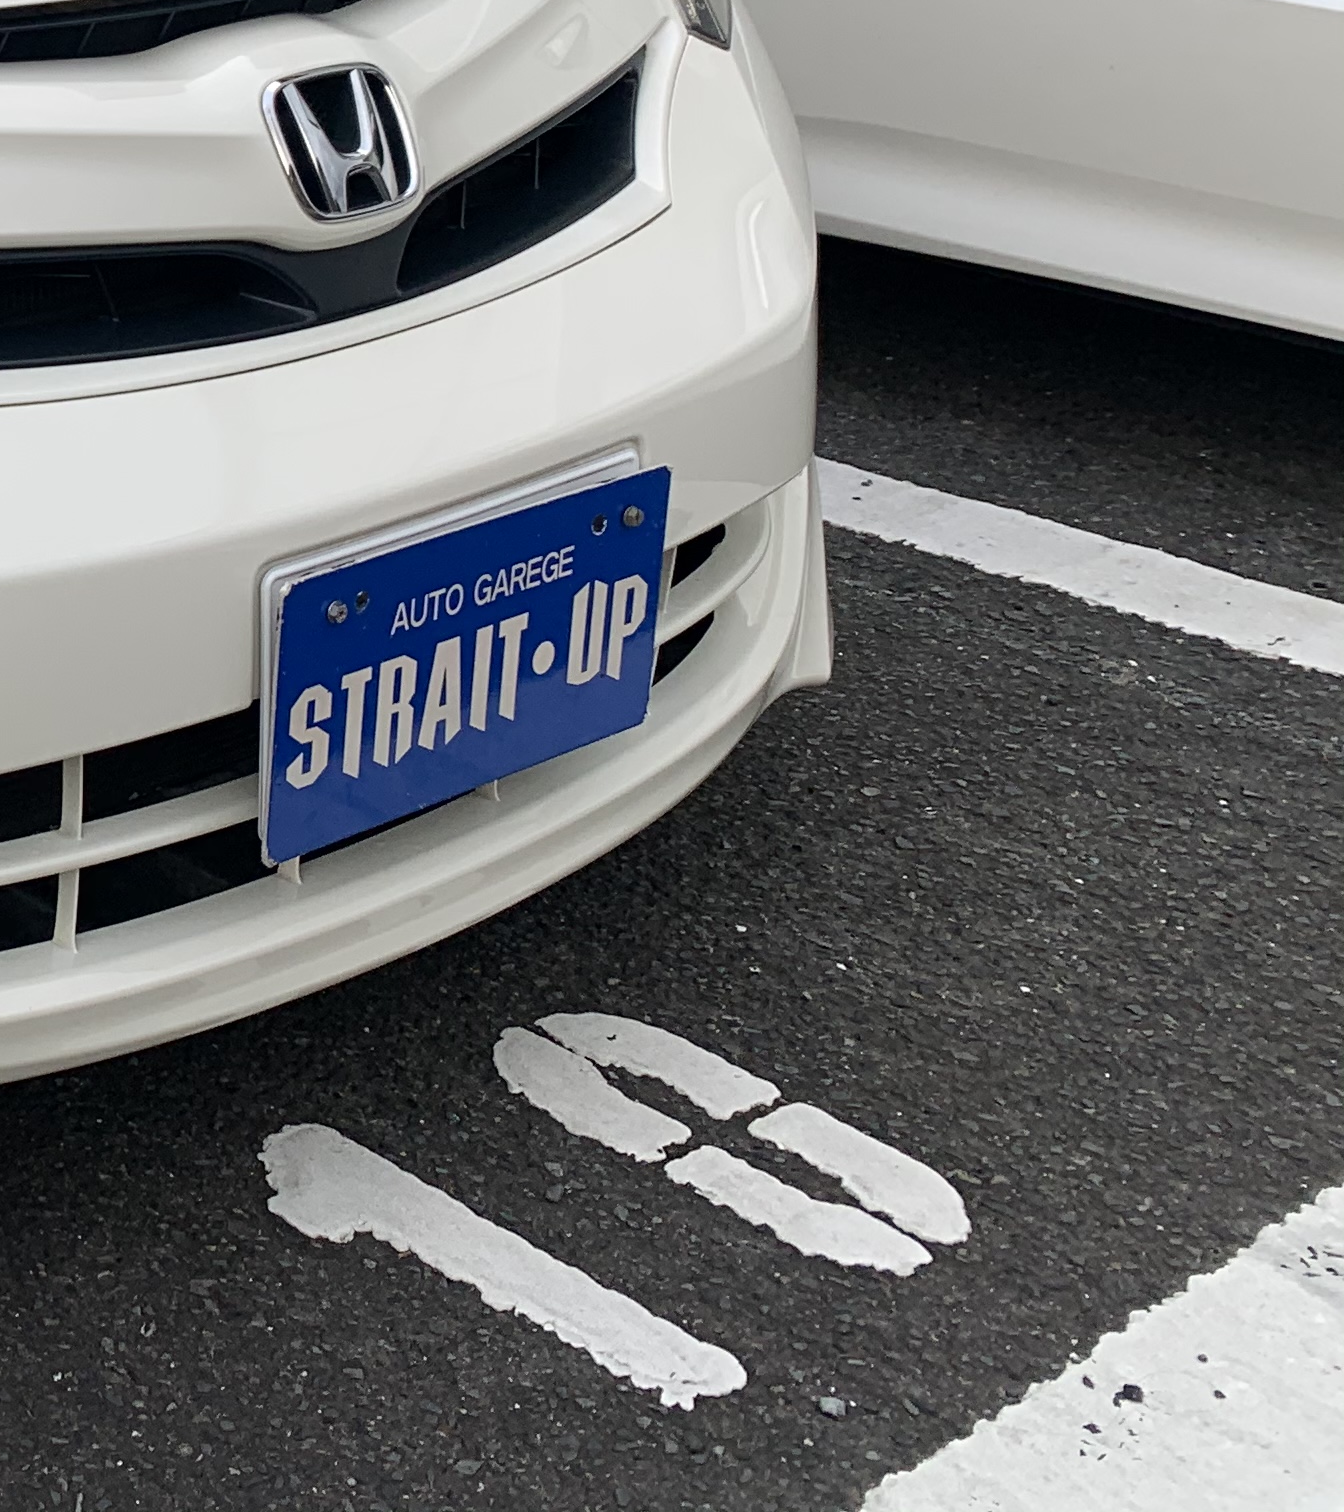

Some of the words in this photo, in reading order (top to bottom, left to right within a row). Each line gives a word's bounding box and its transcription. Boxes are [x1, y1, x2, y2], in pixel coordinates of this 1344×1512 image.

[390, 583, 465, 637] AUTO
[473, 544, 576, 607] GAREGE
[256, 1011, 972, 1411] 10
